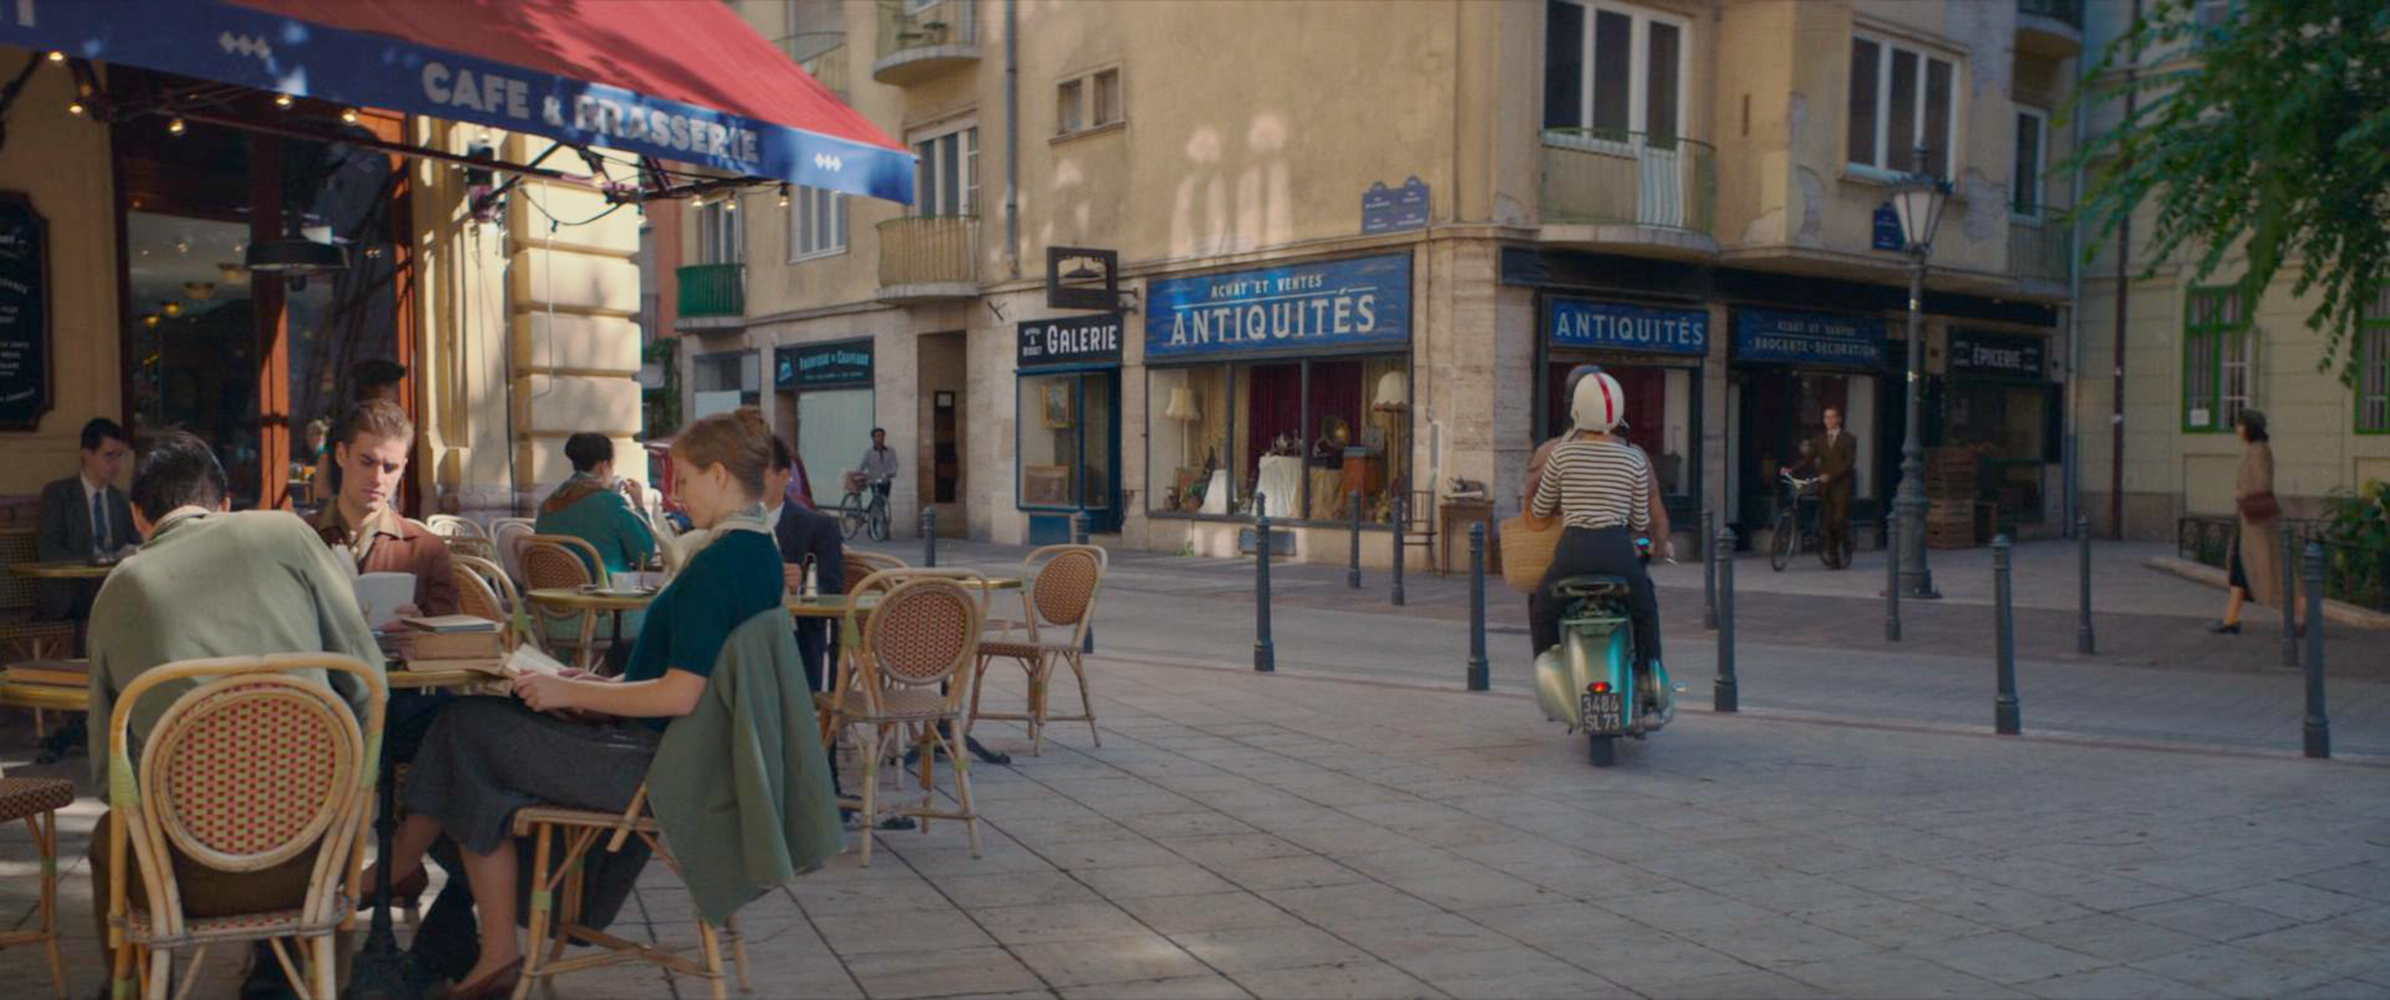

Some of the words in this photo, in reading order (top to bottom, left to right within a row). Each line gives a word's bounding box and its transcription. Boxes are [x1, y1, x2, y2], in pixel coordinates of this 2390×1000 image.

[422, 61, 530, 119] CAFE
[542, 95, 565, 125] &
[573, 93, 759, 164] BRASSERIE
[1210, 281, 1248, 299] ACHAT
[1254, 279, 1270, 294] ET
[1276, 273, 1323, 291] VENTES
[1169, 288, 1376, 346] ANTIQUITÉS
[1555, 312, 1704, 345] ANTIQUITÉS
[1046, 324, 1118, 355] GALERIE
[1972, 342, 2021, 369] ÉPICERIE
